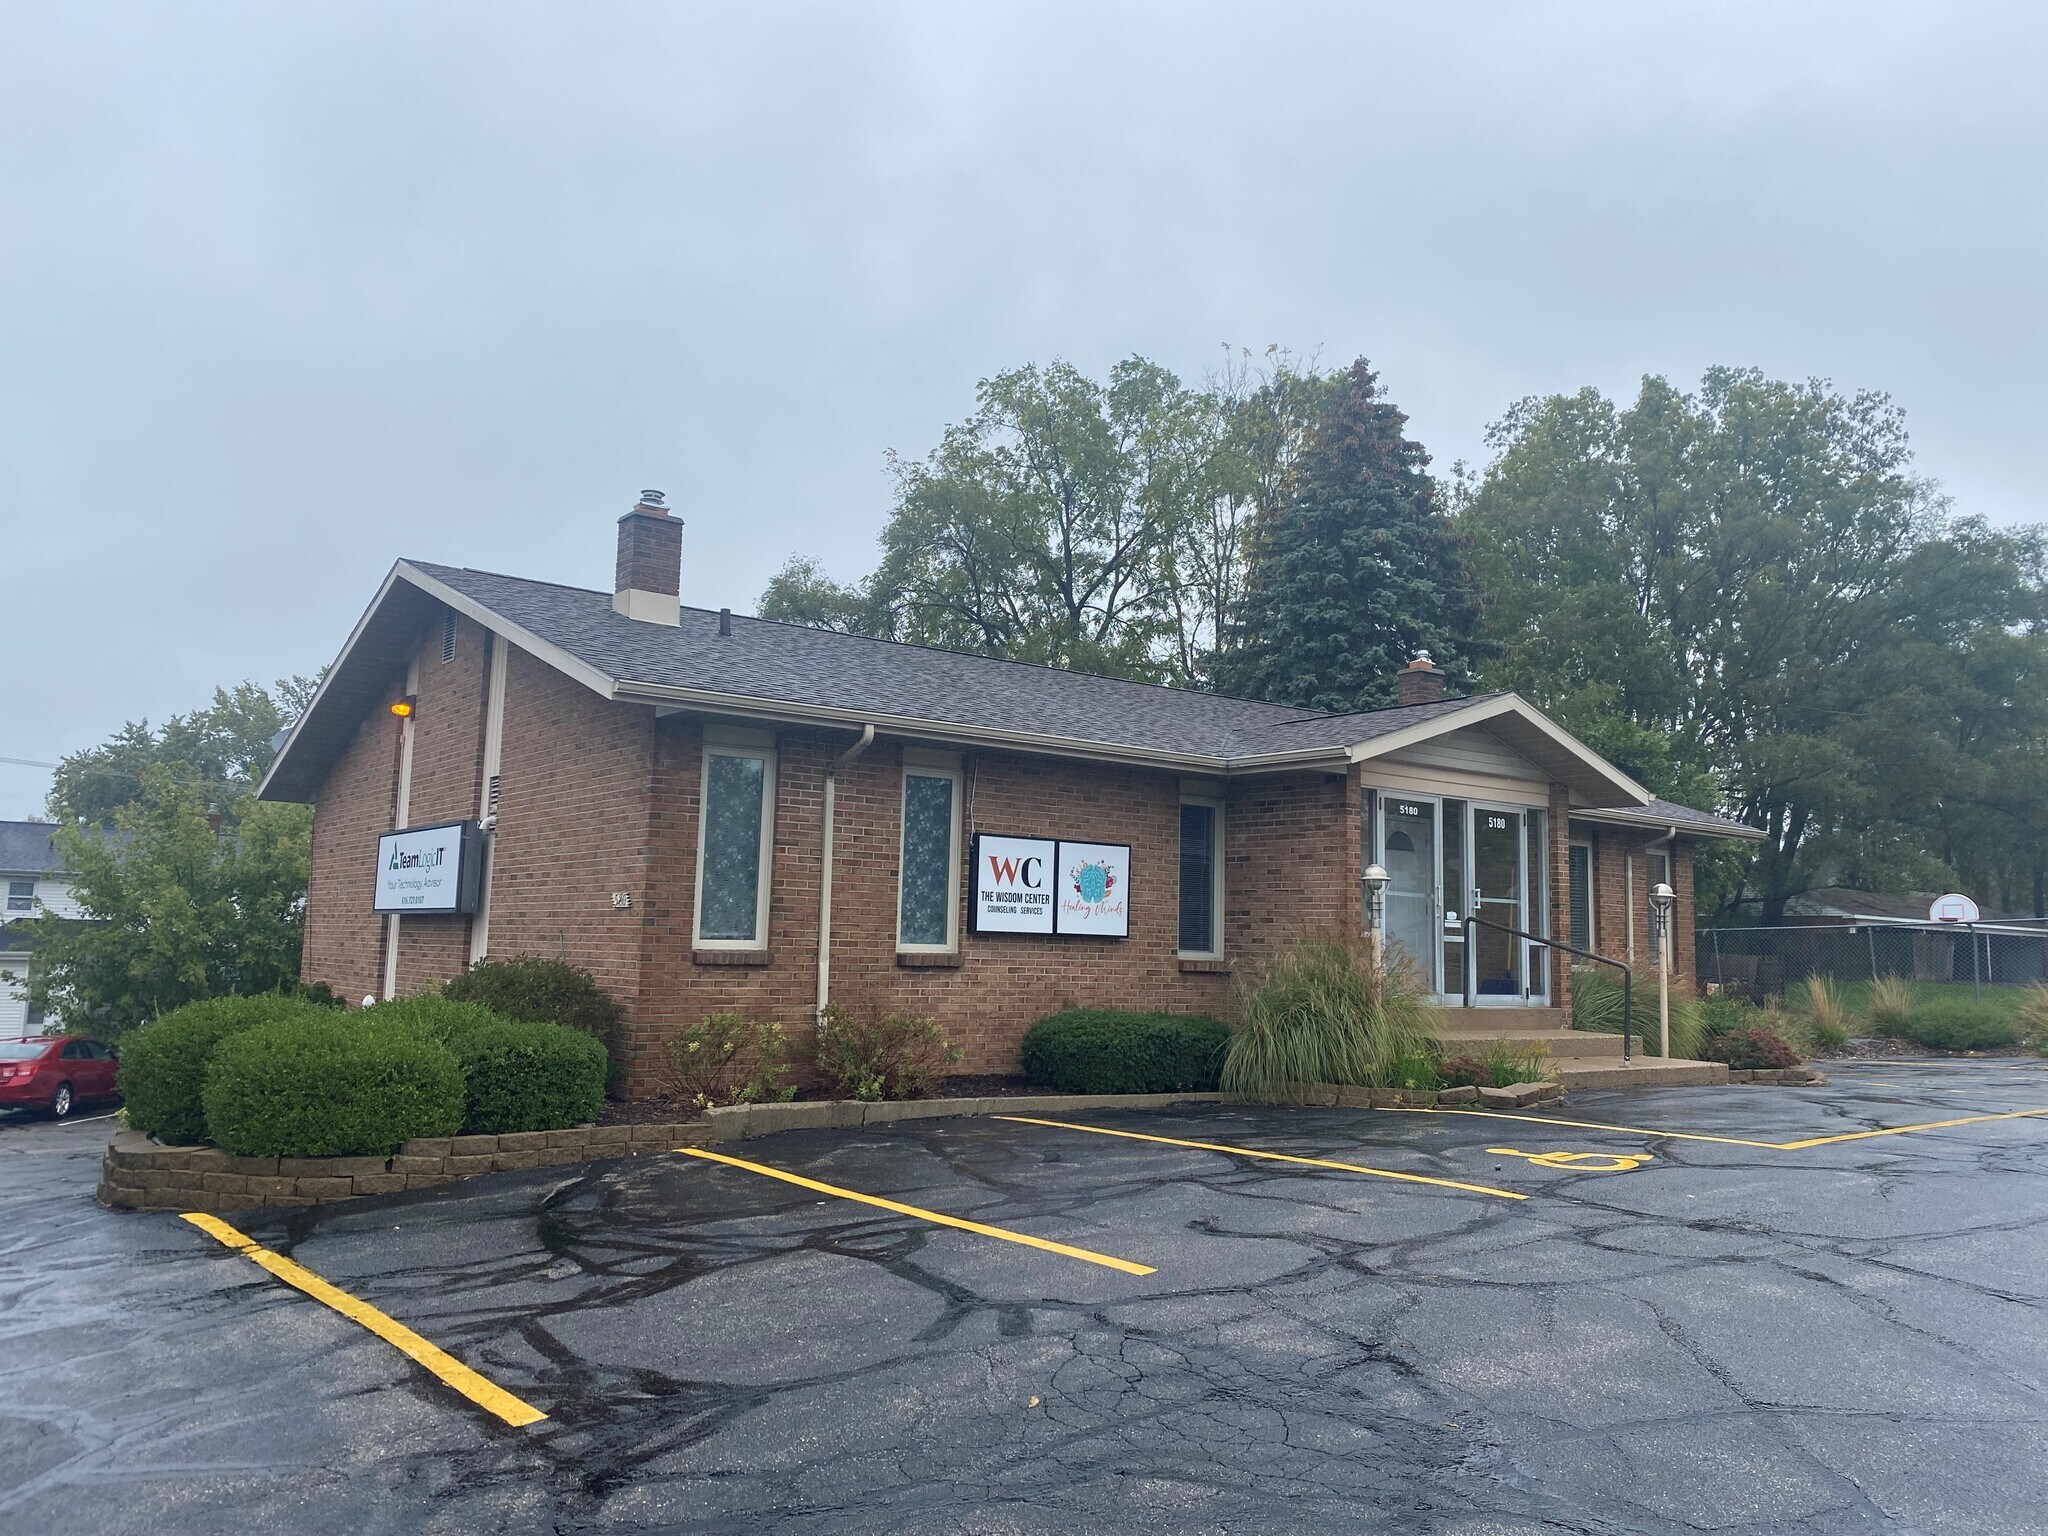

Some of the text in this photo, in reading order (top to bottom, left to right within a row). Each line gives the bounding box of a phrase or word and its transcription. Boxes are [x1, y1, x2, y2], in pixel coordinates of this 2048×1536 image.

[1399, 805, 1419, 816] 5180
[1488, 816, 1506, 829] 5180
[988, 855, 1042, 888] WC
[398, 877, 422, 891] Technology
[423, 877, 442, 888] Advisor
[981, 890, 1050, 905] THE WISDOM CENTER
[987, 905, 1043, 915] COUNSELING SERVICES
[1061, 899, 1123, 919] Healing Minds
